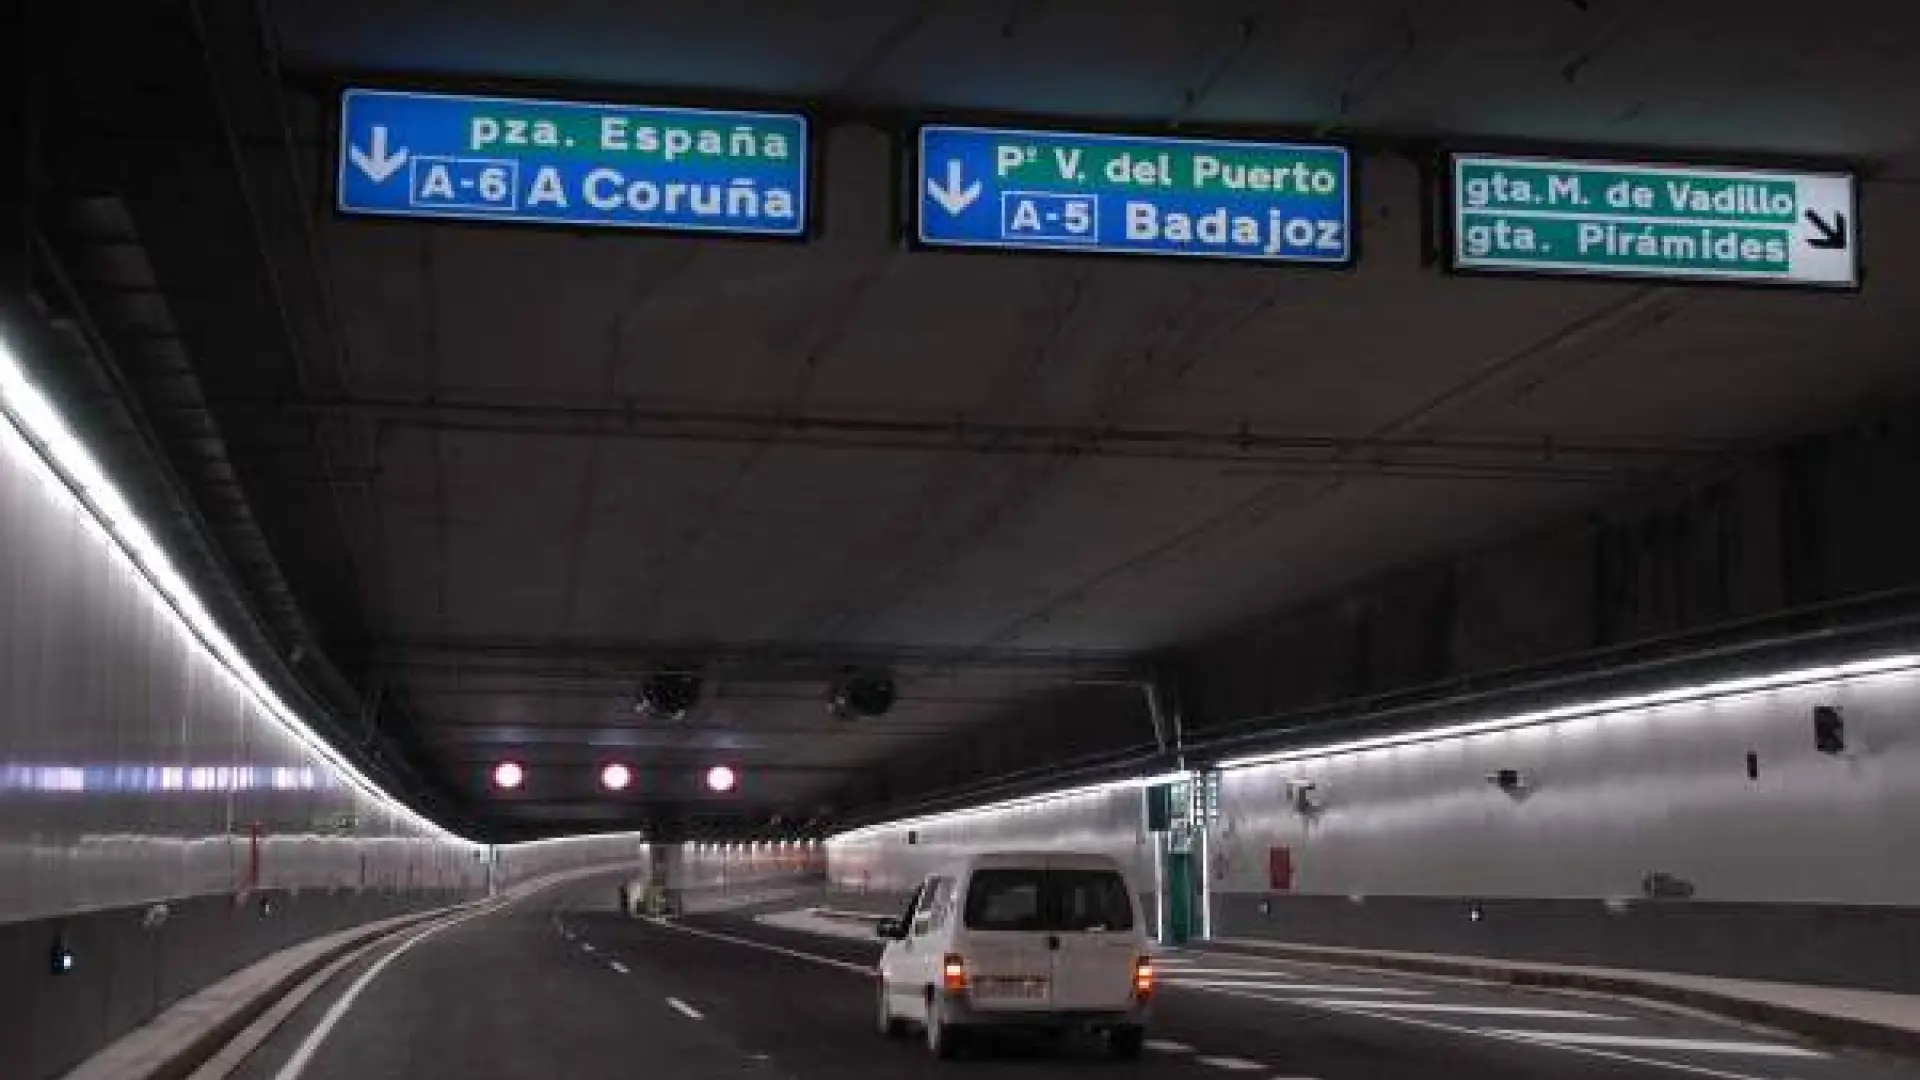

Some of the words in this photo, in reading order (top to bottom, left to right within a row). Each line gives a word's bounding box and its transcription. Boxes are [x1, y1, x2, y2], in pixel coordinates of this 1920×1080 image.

[470, 117, 576, 151] pza.
[600, 117, 789, 160] España
[421, 164, 511, 201] A-6
[527, 166, 568, 208] A
[582, 168, 795, 218] Coruña
[1054, 147, 1085, 184] V.
[1104, 152, 1172, 187] del
[1193, 155, 1337, 194] Puerto
[1605, 180, 1655, 209] de
[1667, 180, 1794, 215] Vadillo
[1010, 200, 1090, 233] A-5
[1125, 202, 1342, 255] Badajoz
[1465, 219, 1551, 254] gta.
[1577, 222, 1786, 263] Pirámides
